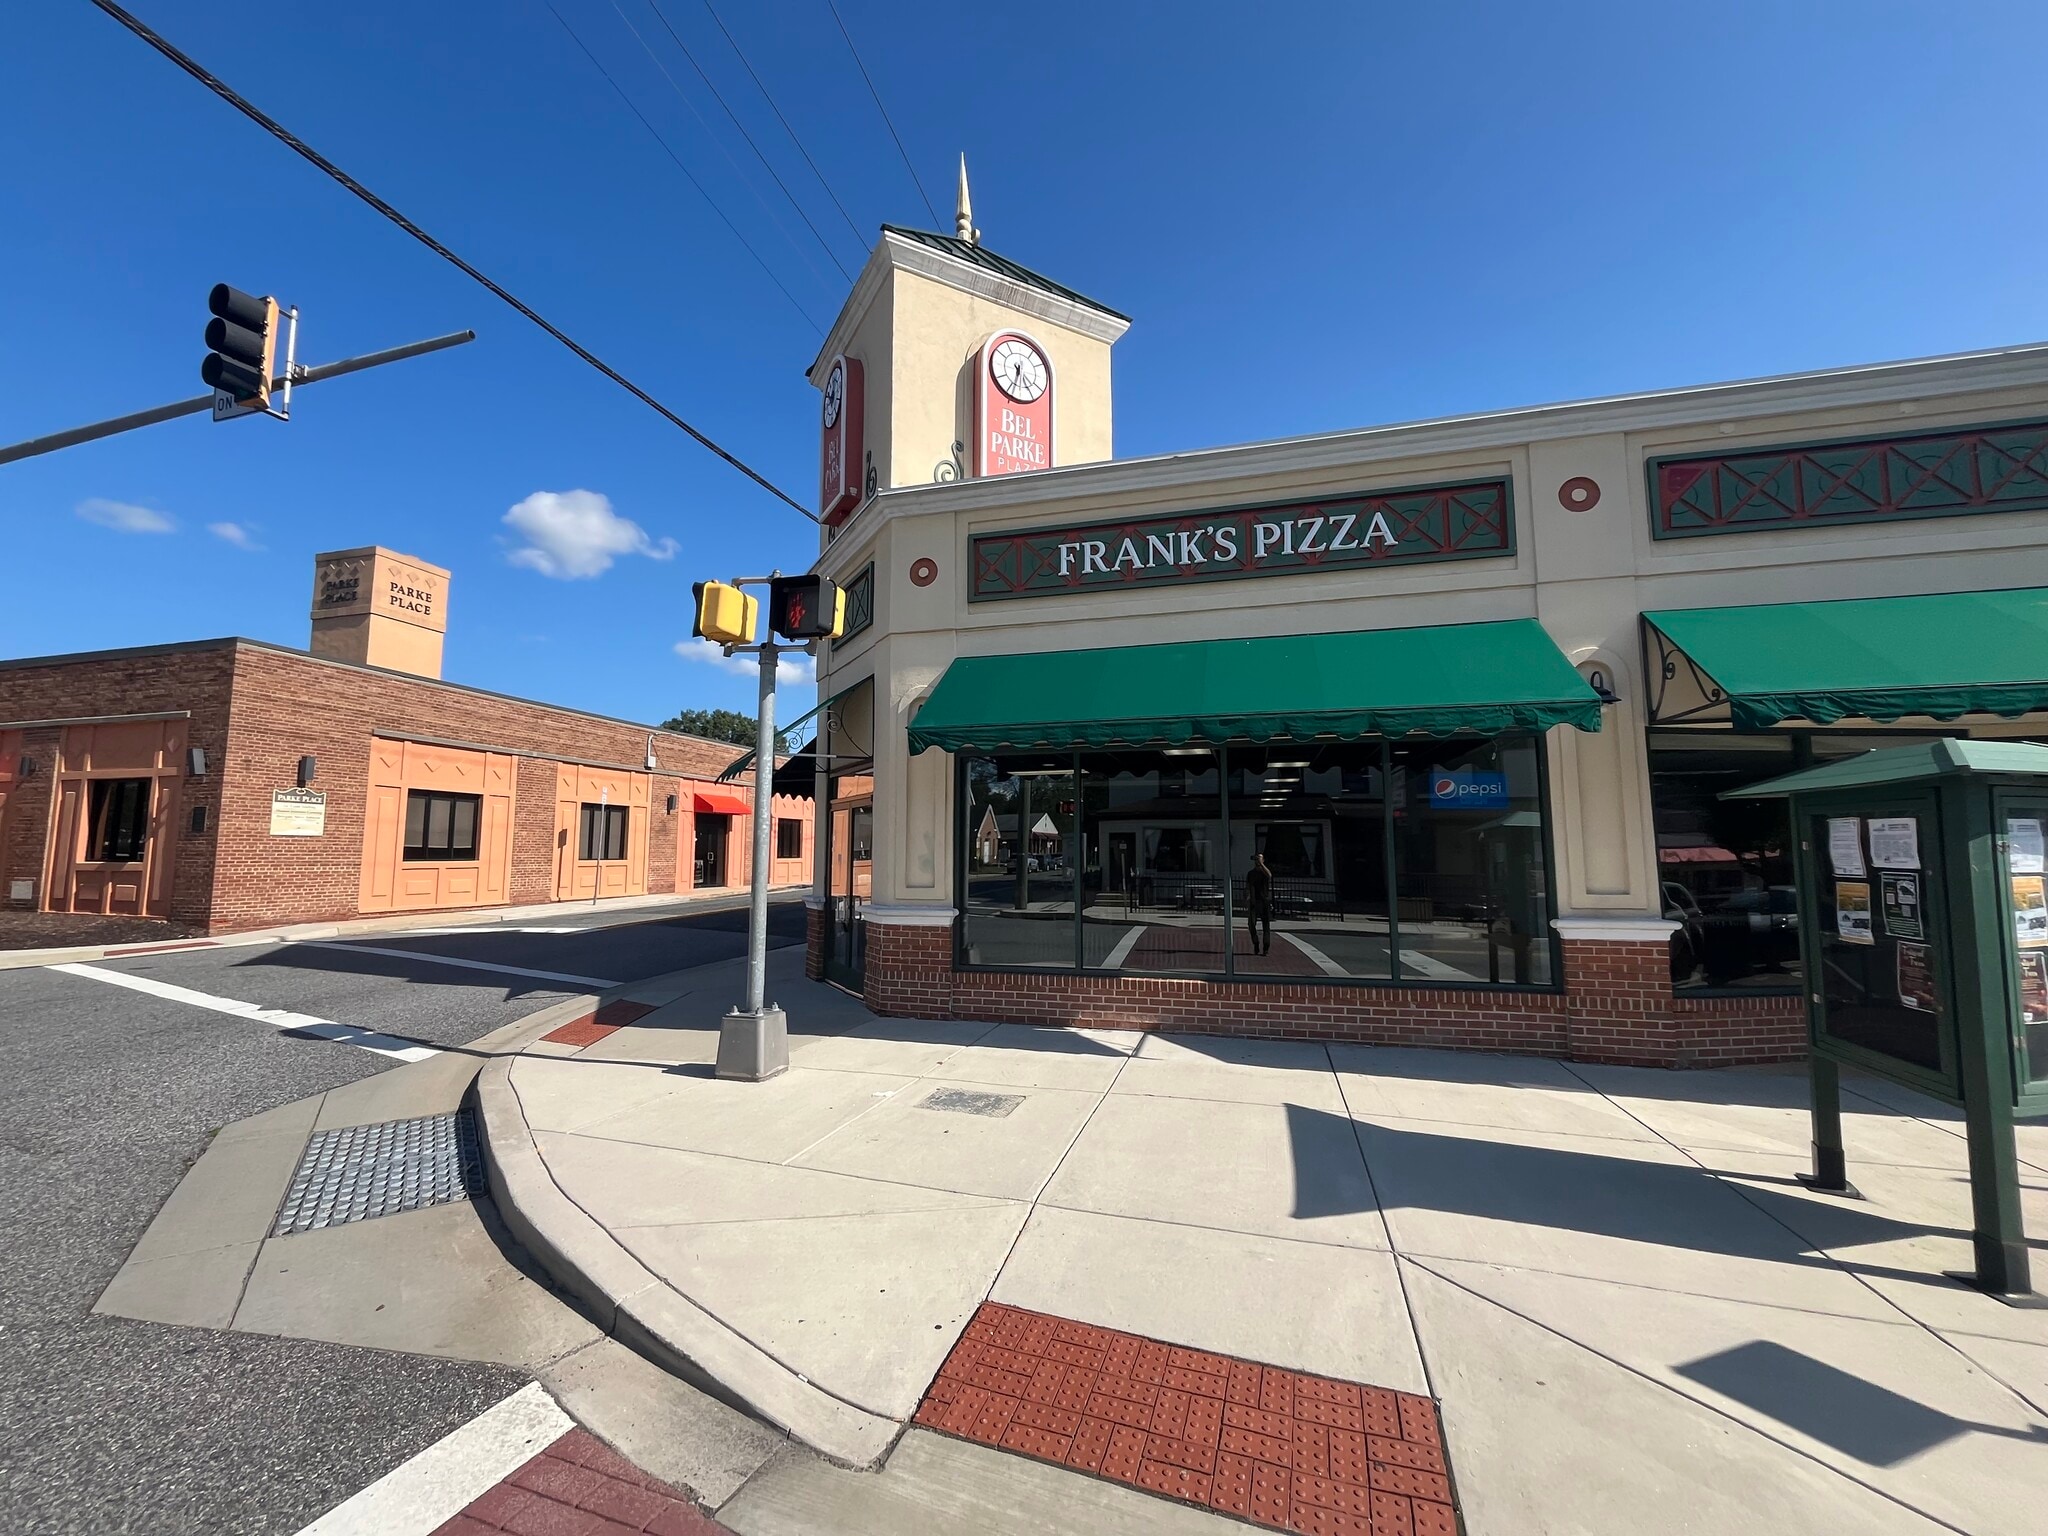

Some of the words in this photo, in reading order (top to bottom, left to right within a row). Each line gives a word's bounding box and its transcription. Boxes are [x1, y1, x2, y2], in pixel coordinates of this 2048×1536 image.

[218, 396, 233, 411] ON
[1001, 408, 1036, 440] BEL
[991, 431, 1046, 465] PARKE
[1058, 526, 1238, 576] FRANK'S
[1254, 511, 1399, 557] PIZZA
[327, 578, 359, 591] PARKE
[390, 581, 432, 603] PARKE
[390, 595, 431, 615] PLACE
[1459, 782, 1502, 796] pepsi
